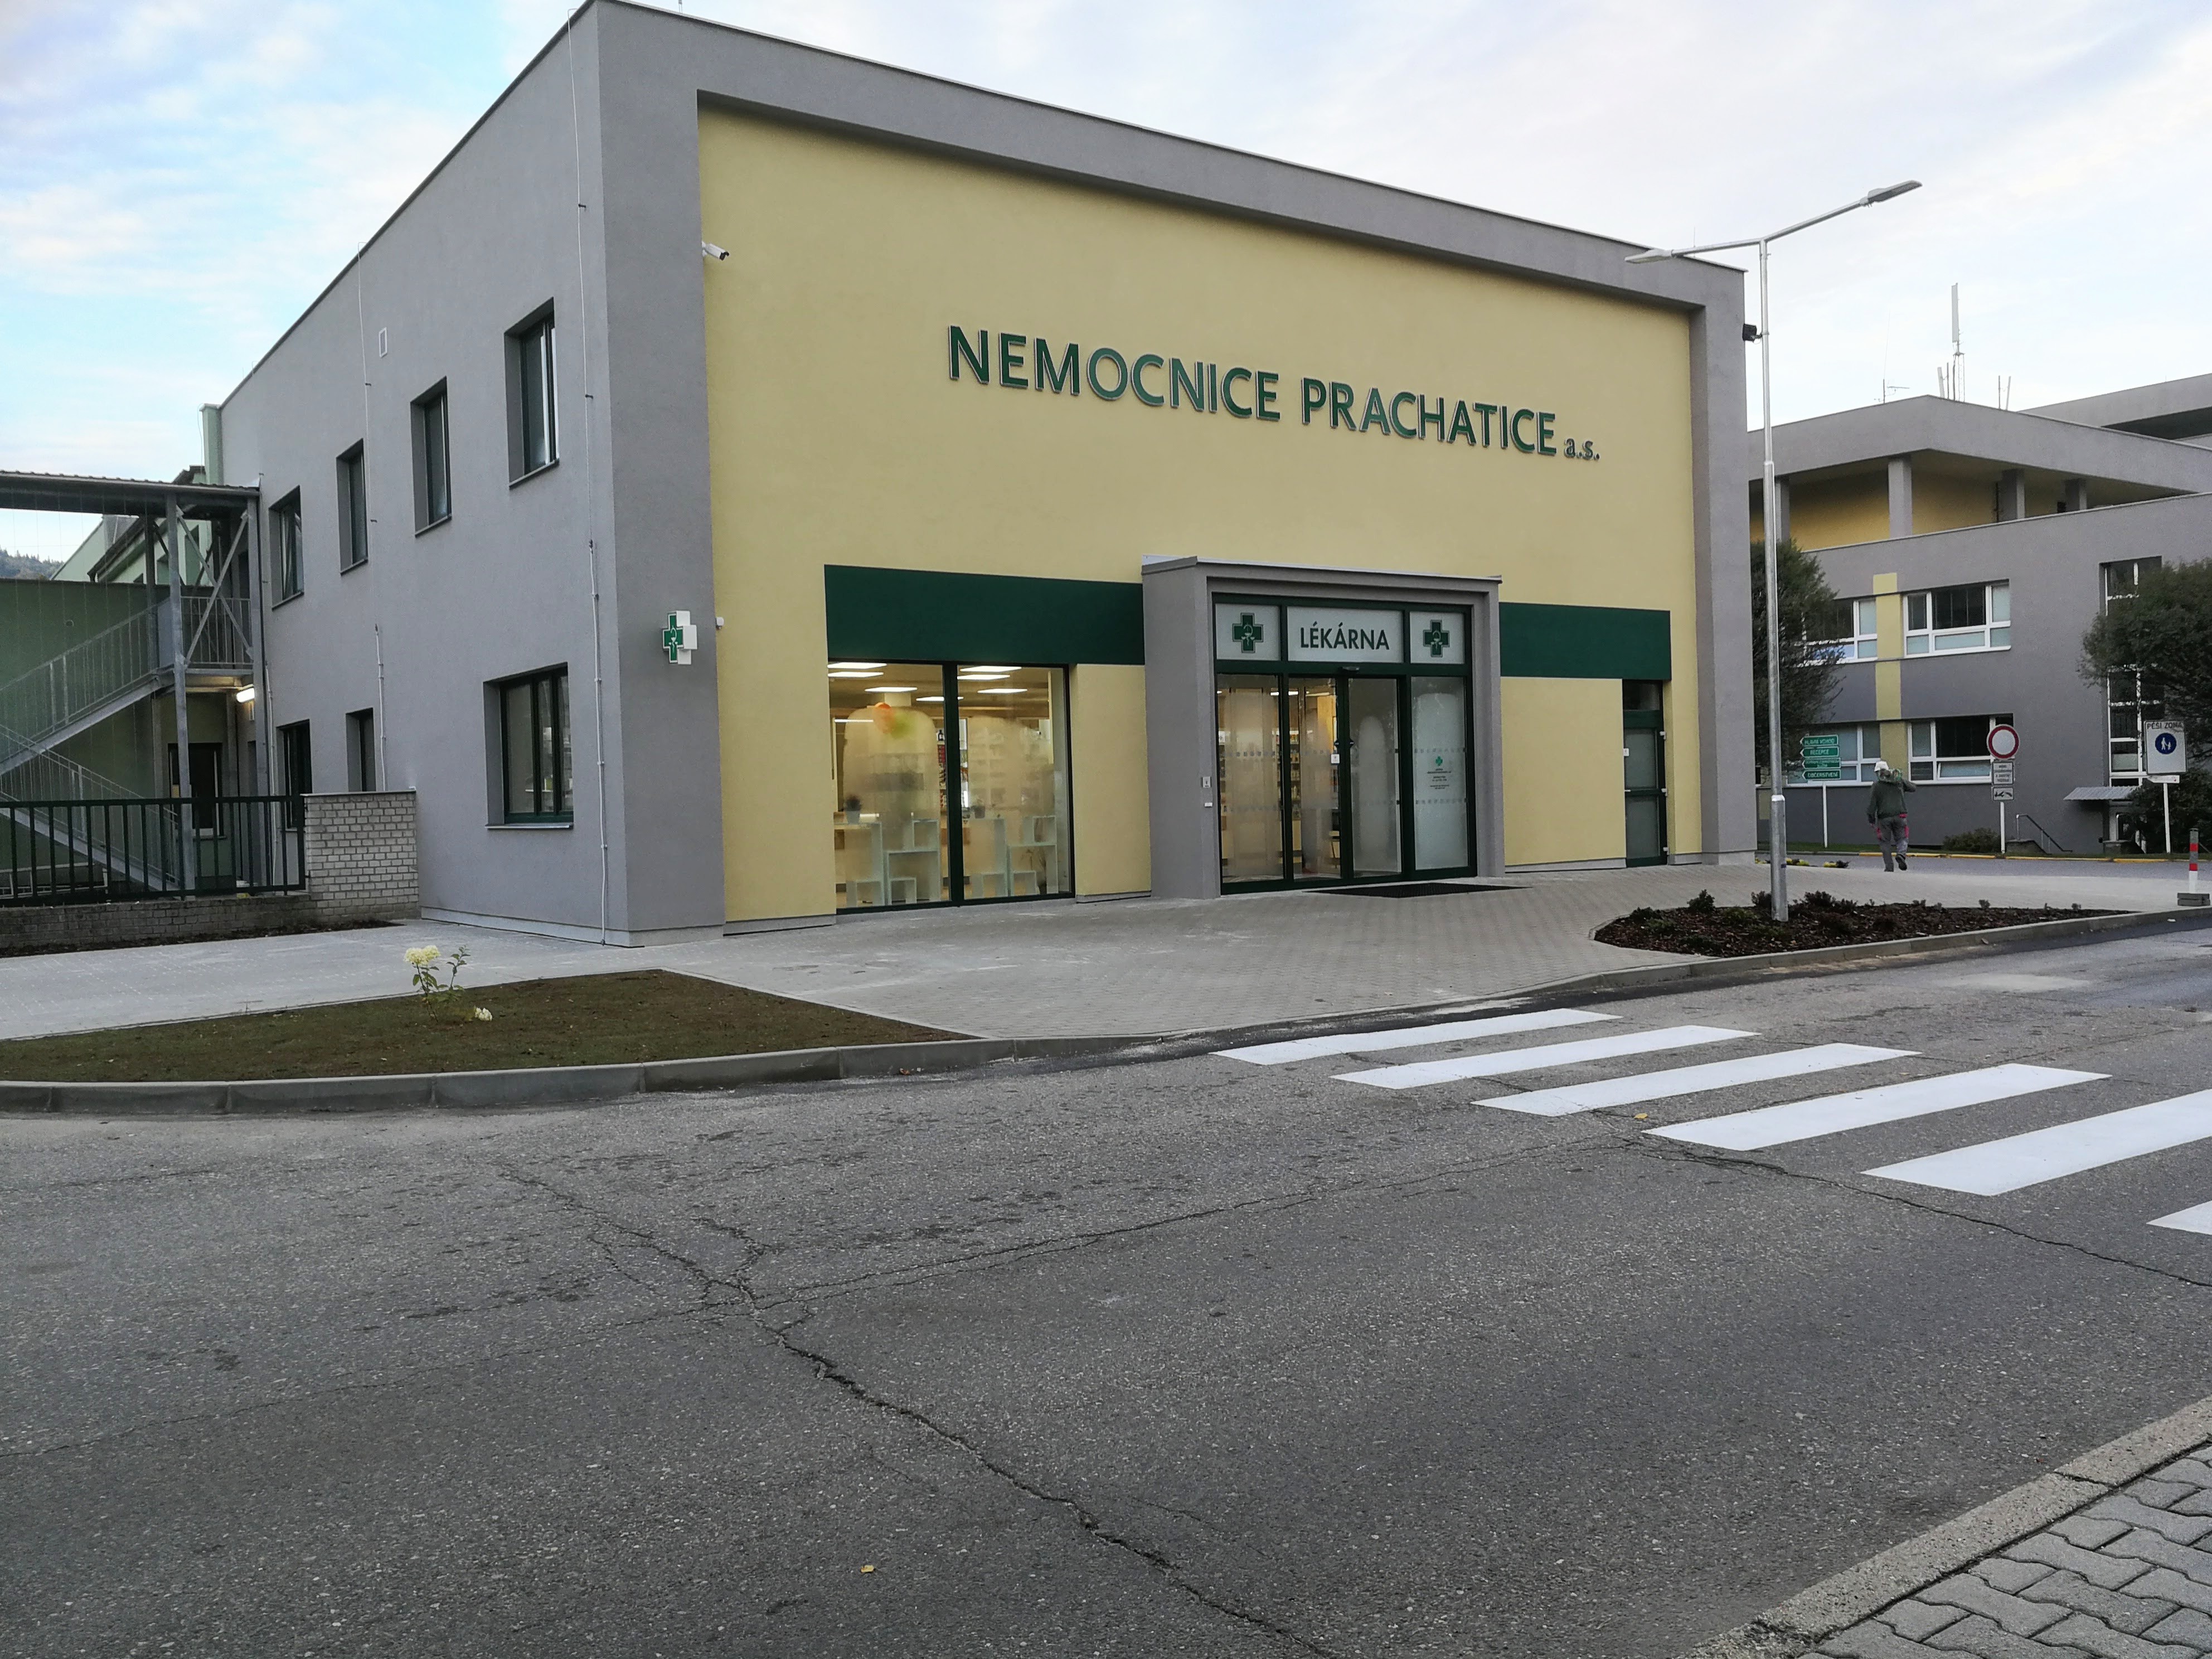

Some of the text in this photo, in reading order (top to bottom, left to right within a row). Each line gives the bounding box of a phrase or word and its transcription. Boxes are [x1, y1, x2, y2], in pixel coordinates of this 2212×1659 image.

[949, 325, 1600, 460] NEMOCNICE PRACHATICE a.s.
[1301, 621, 1389, 650] LÉKÁRNA
